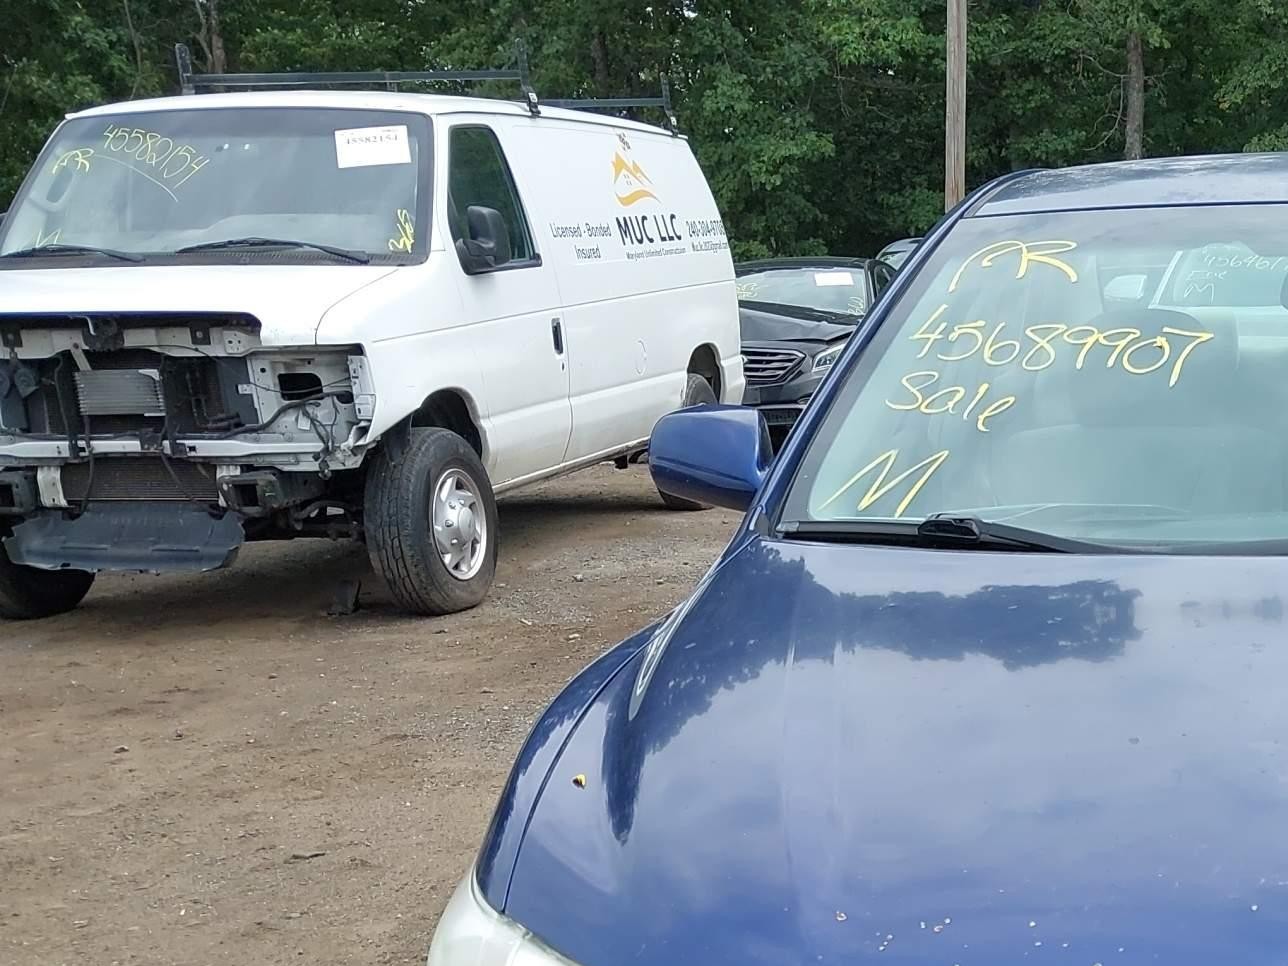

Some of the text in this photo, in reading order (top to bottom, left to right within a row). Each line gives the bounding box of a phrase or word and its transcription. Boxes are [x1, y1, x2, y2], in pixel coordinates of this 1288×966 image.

[103, 124, 210, 189] 45582154
[549, 222, 582, 238] Licensed
[585, 222, 611, 237] Bonded
[574, 244, 601, 260] Insured
[615, 213, 682, 246] MUC LLC
[908, 303, 1215, 388] 45689907
[884, 371, 1016, 432] Sale
[815, 448, 950, 519] M
